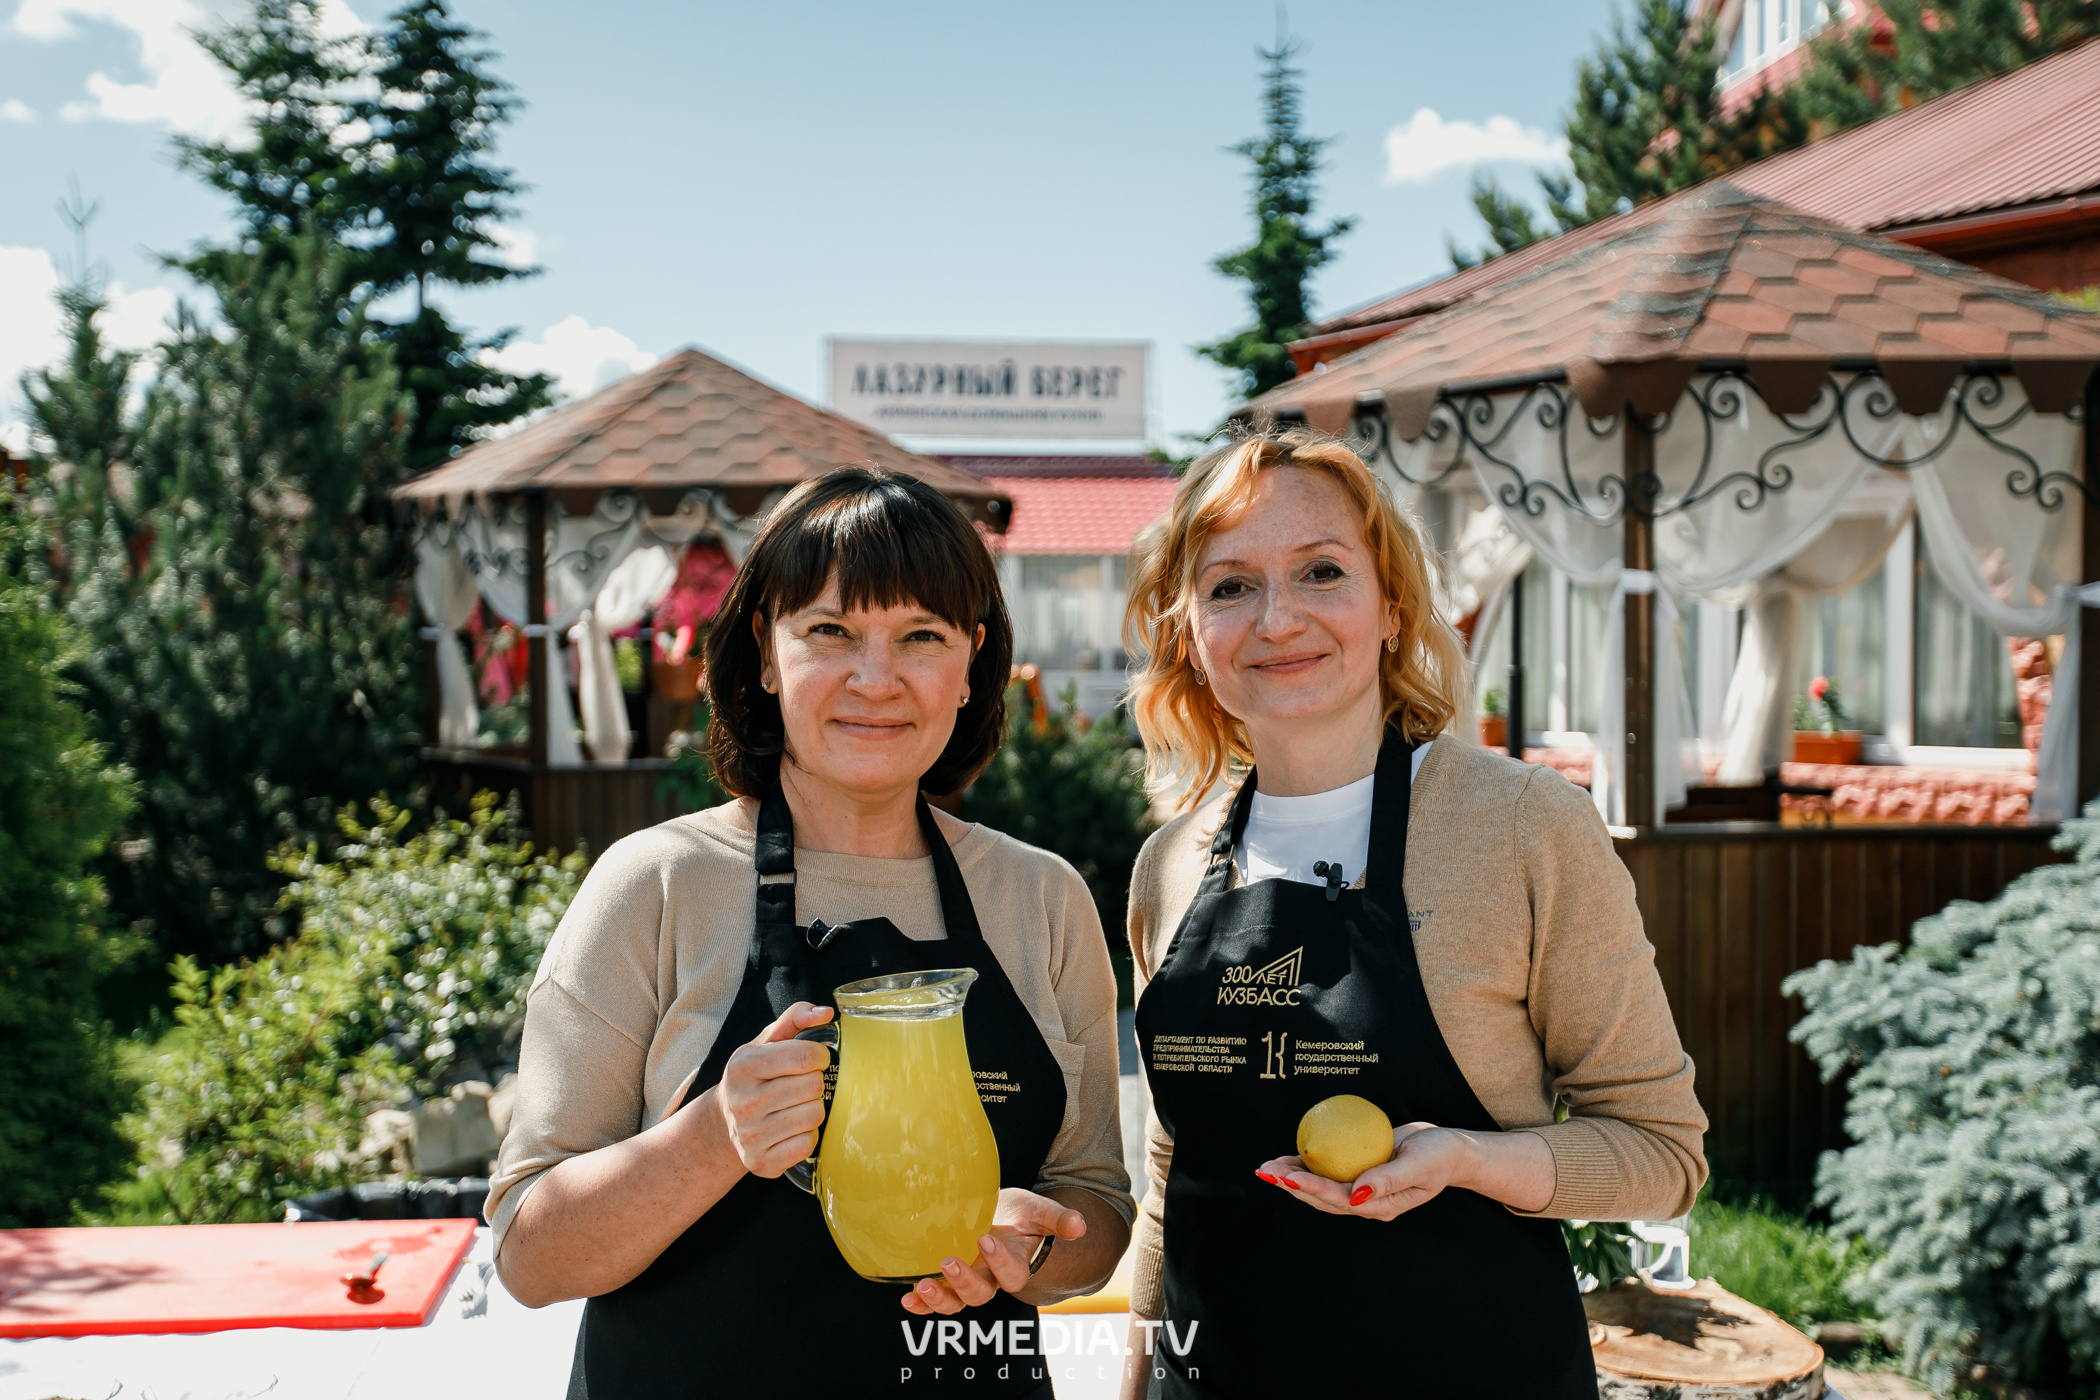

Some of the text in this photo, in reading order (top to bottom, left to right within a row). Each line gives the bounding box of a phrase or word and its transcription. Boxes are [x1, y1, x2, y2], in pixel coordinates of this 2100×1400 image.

[854, 358, 1124, 397] ЛАЗУРНЫЙ БЕРЕГ
[1222, 965, 1252, 984] 300
[1217, 987, 1302, 1006] КУЗБАСС
[1154, 1035, 1247, 1046] ДЕПАРТАМЕНТ ПО РАЗВИТИЮ
[1295, 1040, 1365, 1051] Кемеровский
[1153, 1044, 1230, 1054] ПРЕДПРИНИМАТЕЛЬСТВА
[1157, 1054, 1220, 1063] ПОТРЕБИТЕЛЬСКОГО
[1221, 1056, 1247, 1065] РЫНКА
[1295, 1053, 1379, 1063] государственный
[1153, 1063, 1233, 1073] КЕМЕРОВСКОЙ ОБЛАСТИ
[1293, 1065, 1361, 1076] университет
